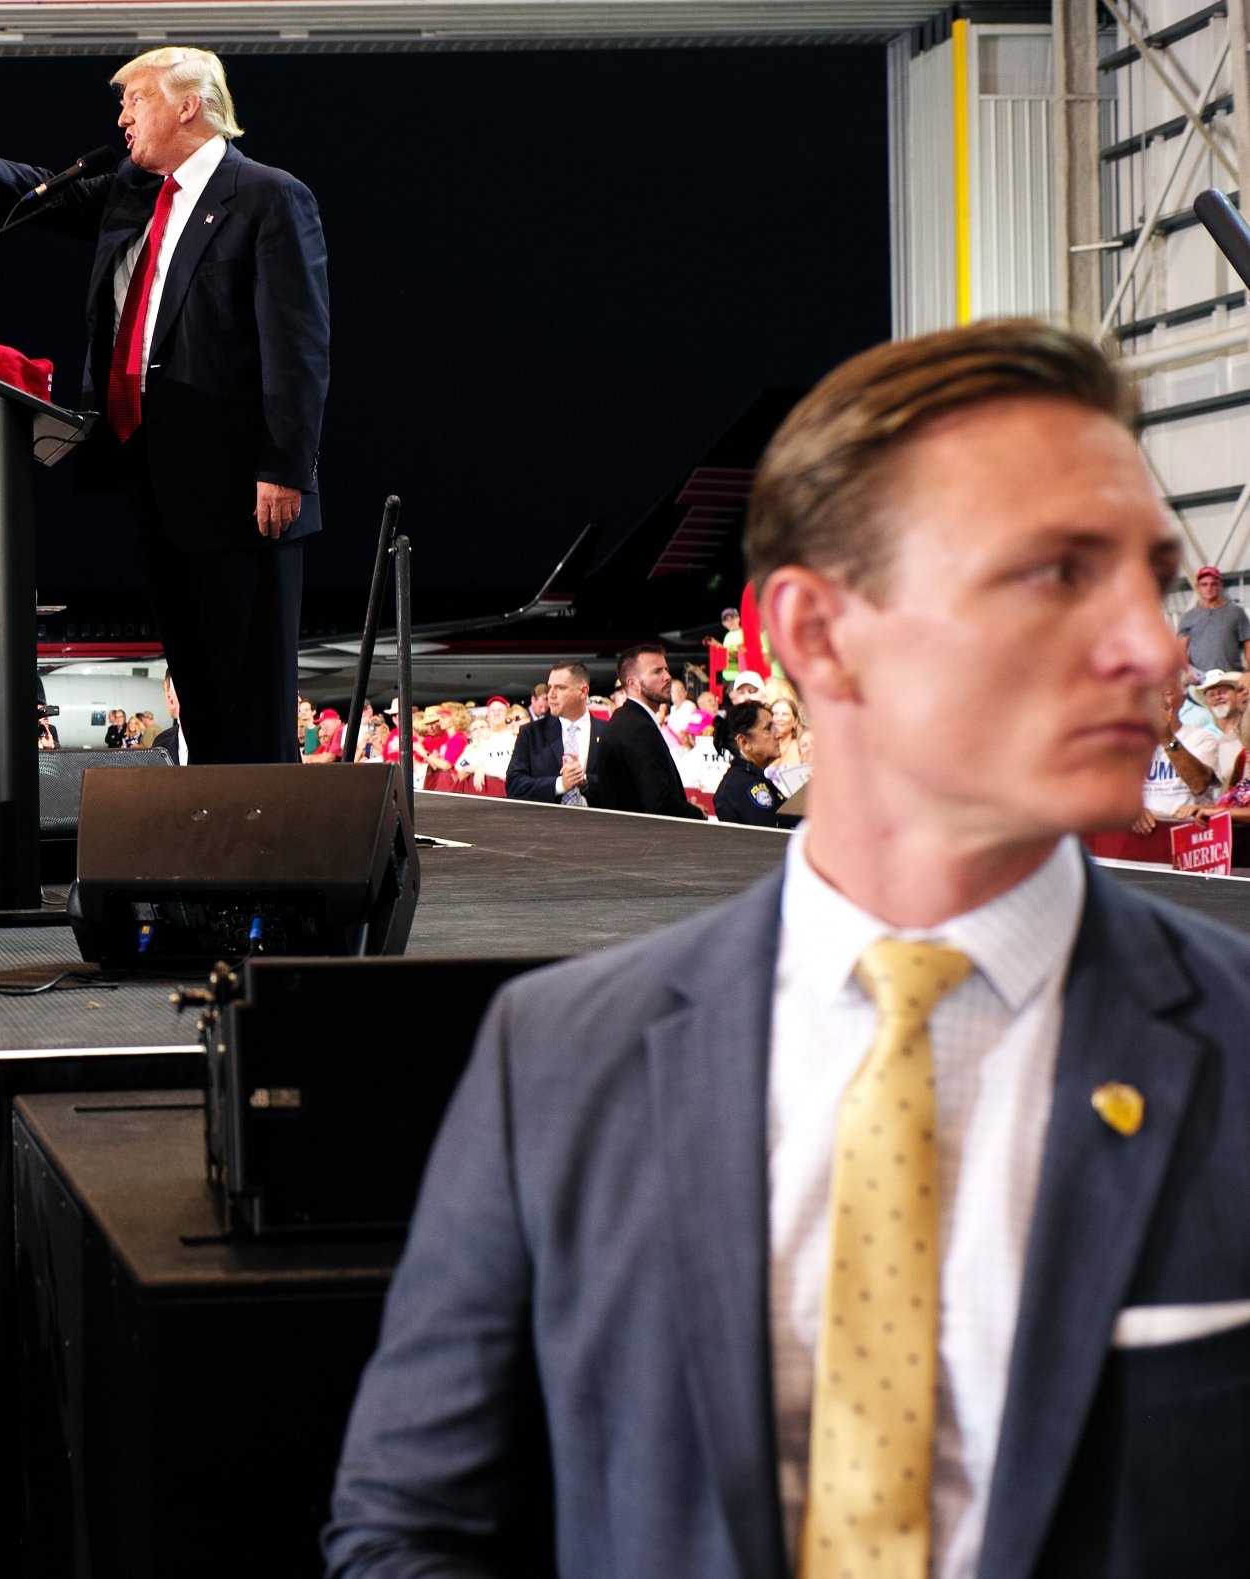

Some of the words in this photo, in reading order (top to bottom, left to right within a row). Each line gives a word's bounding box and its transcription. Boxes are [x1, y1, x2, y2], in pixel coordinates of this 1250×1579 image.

[1146, 761, 1179, 781] UM
[1191, 829, 1214, 845] MAKE
[1175, 841, 1230, 870] AMERICA
